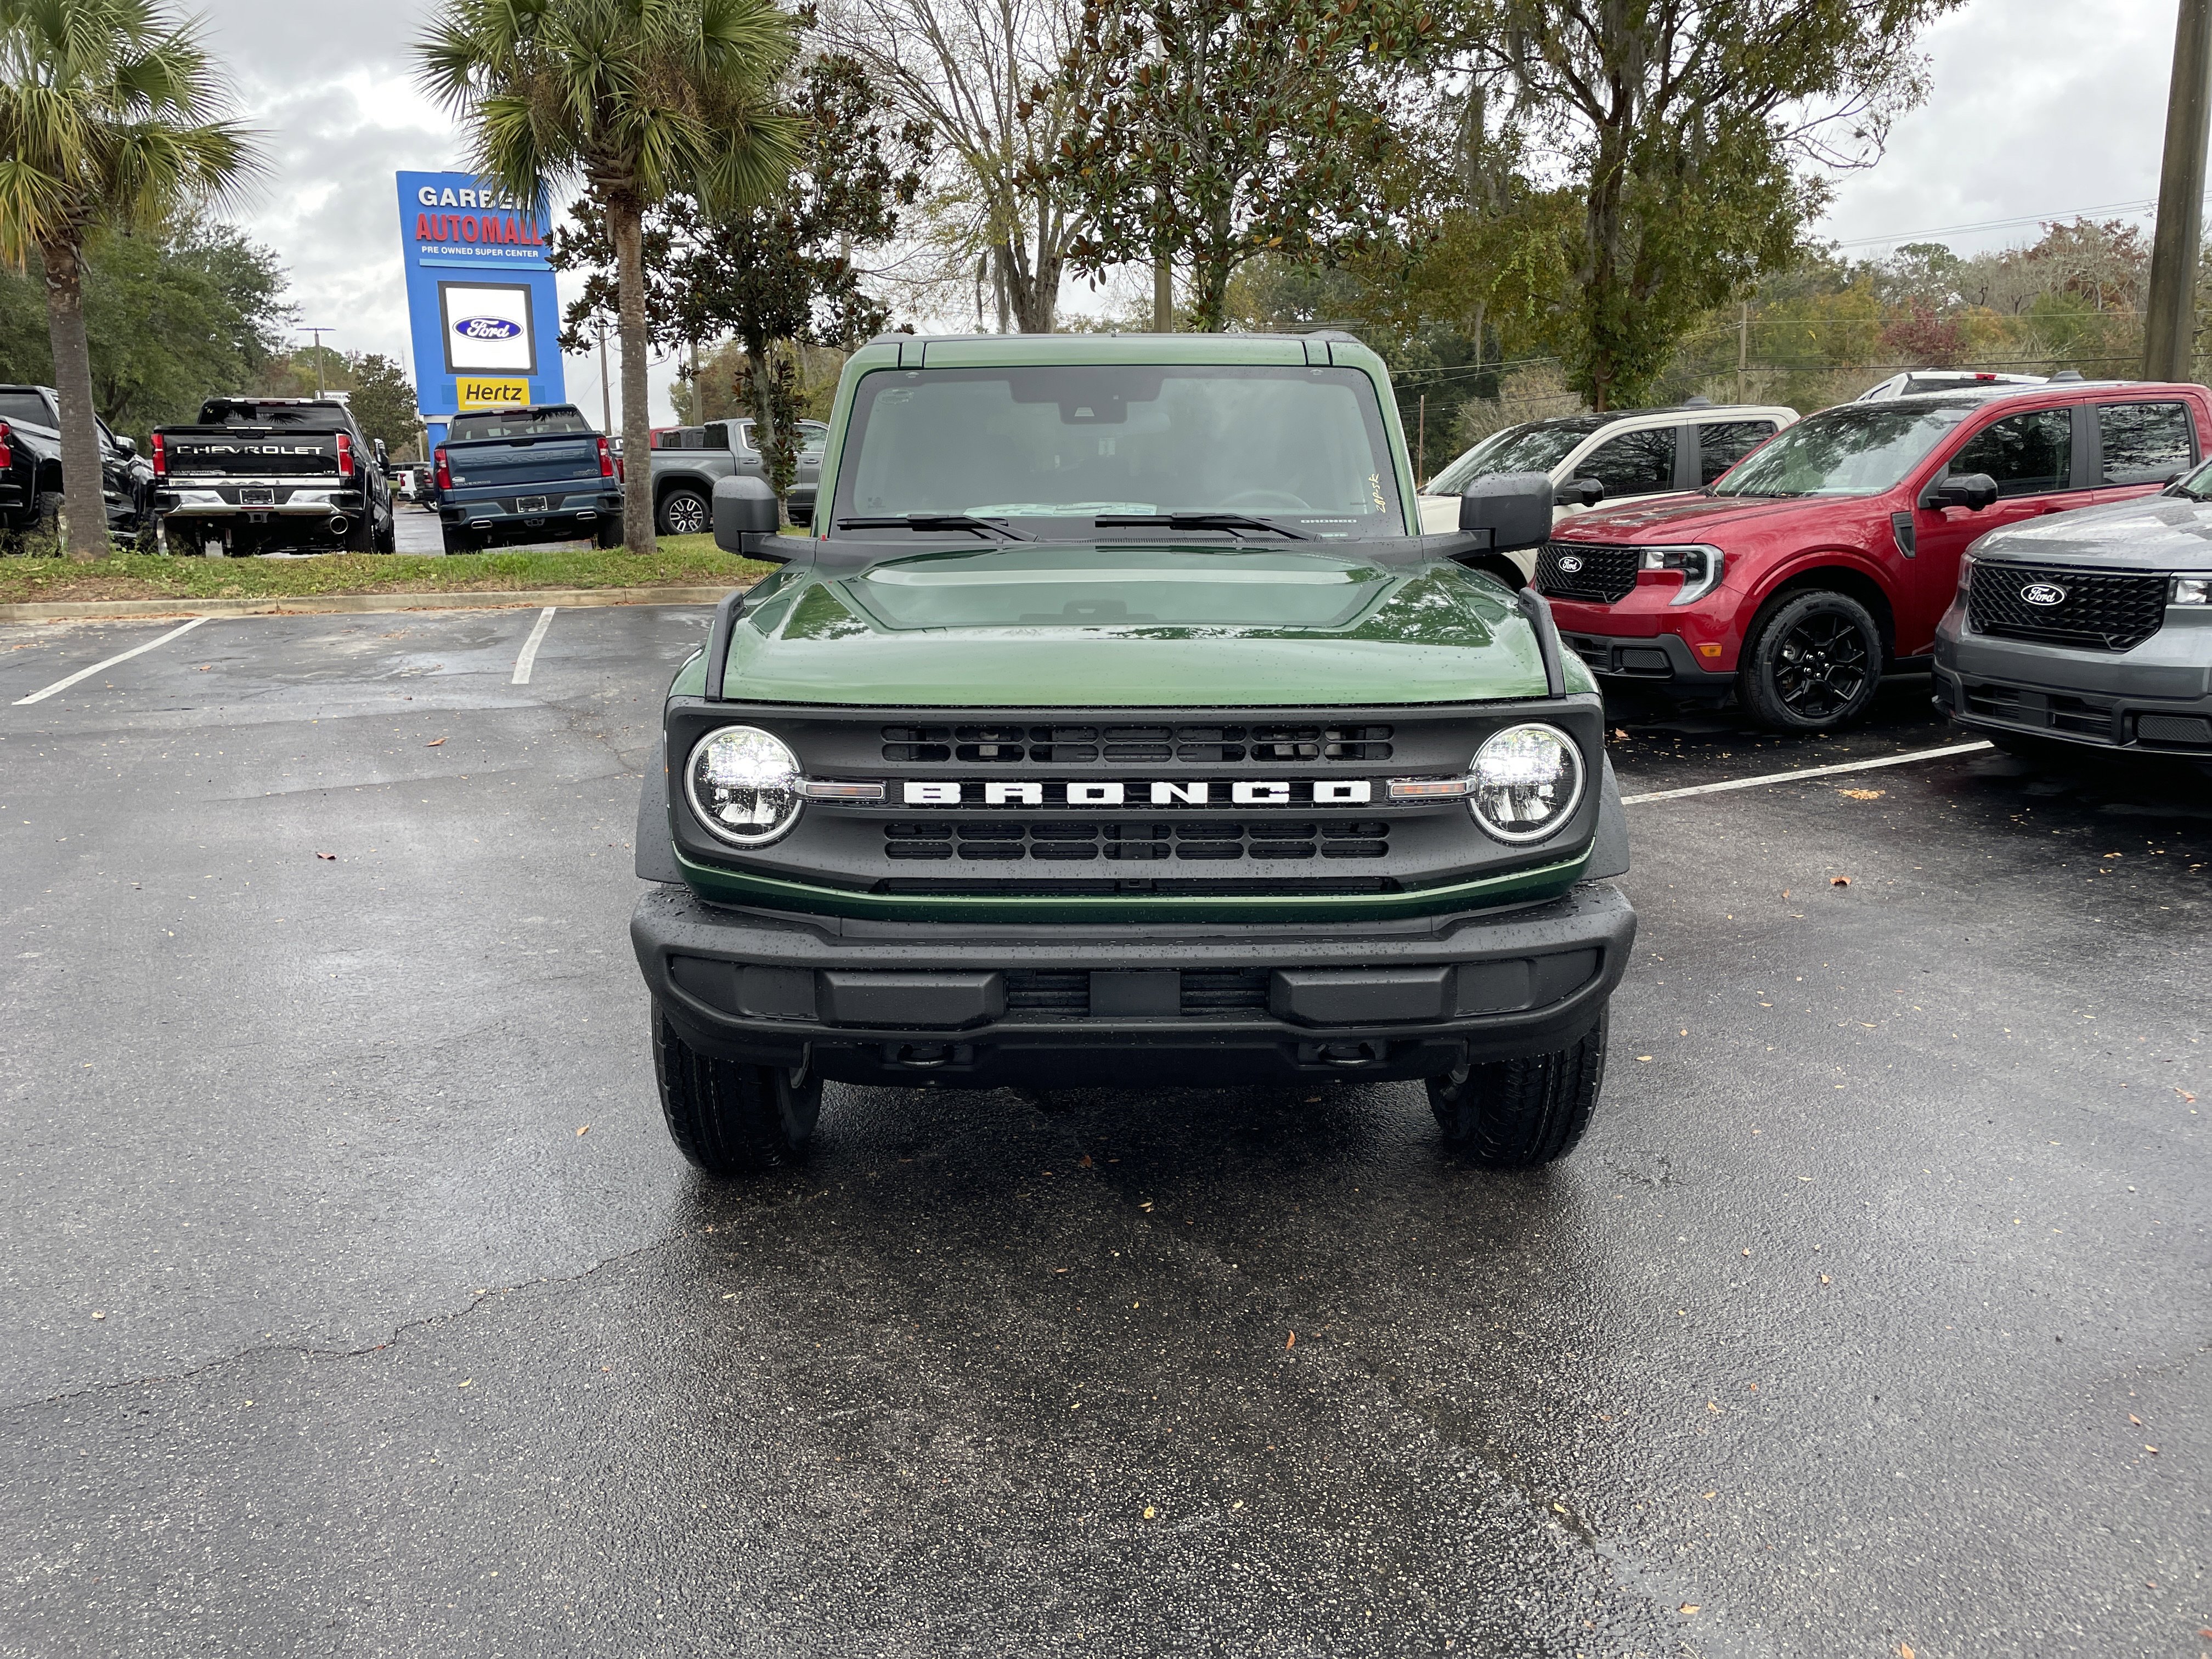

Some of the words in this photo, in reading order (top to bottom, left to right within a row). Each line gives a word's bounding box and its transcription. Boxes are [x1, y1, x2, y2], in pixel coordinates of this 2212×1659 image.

[441, 247, 473, 255] OWNED
[475, 248, 503, 256] SUPER
[505, 249, 538, 257] CENTER
[467, 319, 510, 337] Ford
[466, 384, 522, 400] Hertz
[177, 445, 324, 455] CHEVROLET
[459, 448, 587, 466] CHEVROLET
[1562, 558, 1577, 570] Ford
[2028, 586, 2056, 602] Ford
[903, 781, 1371, 805] BRONCO
